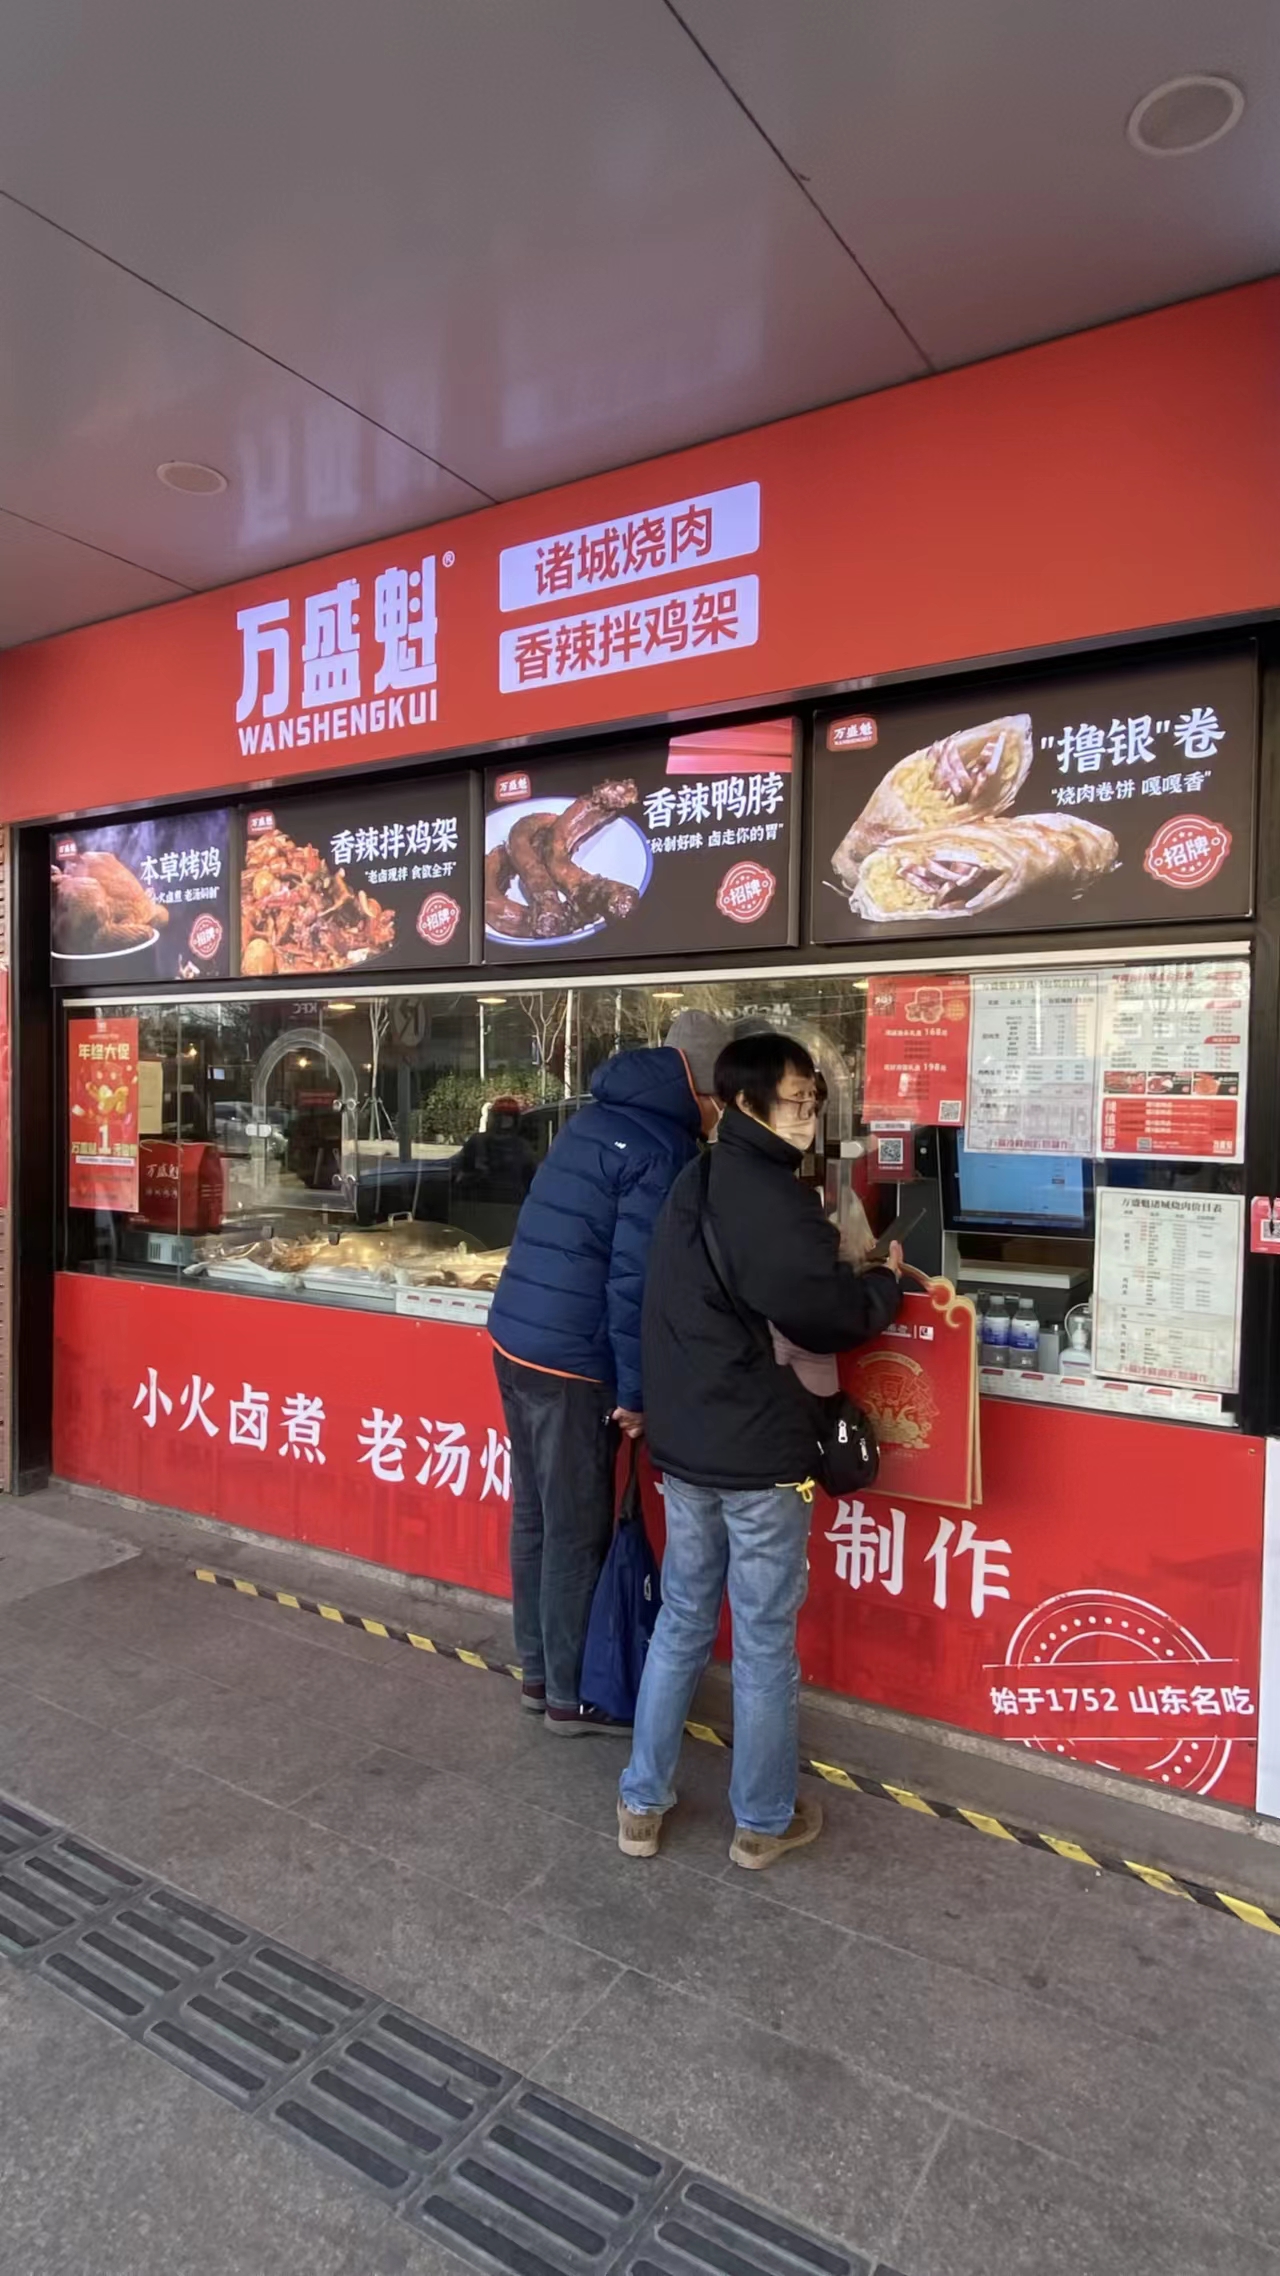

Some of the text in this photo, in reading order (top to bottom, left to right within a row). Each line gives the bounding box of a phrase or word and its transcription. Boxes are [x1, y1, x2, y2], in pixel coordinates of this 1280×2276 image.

[535, 504, 713, 596] 诸城烧肉
[236, 555, 438, 723] 万盛魁
[514, 593, 738, 684] 香辣拌鸡架
[238, 689, 438, 757] WANSHENGKUI
[834, 721, 873, 740] 万盛魁
[642, 771, 784, 830] 香辣鸭脖
[140, 846, 221, 885] 本草烤鸡
[330, 816, 459, 866] 香辣拌鸡架
[1162, 835, 1211, 869] 招牌
[729, 880, 761, 907] 招牌
[426, 908, 452, 930] 招牌
[78, 1043, 131, 1061] 年终大促
[132, 1366, 326, 1465] 小火卤煮
[823, 1500, 1012, 1618] 制作
[989, 1685, 1255, 1716] 始于1752 山东名吃
